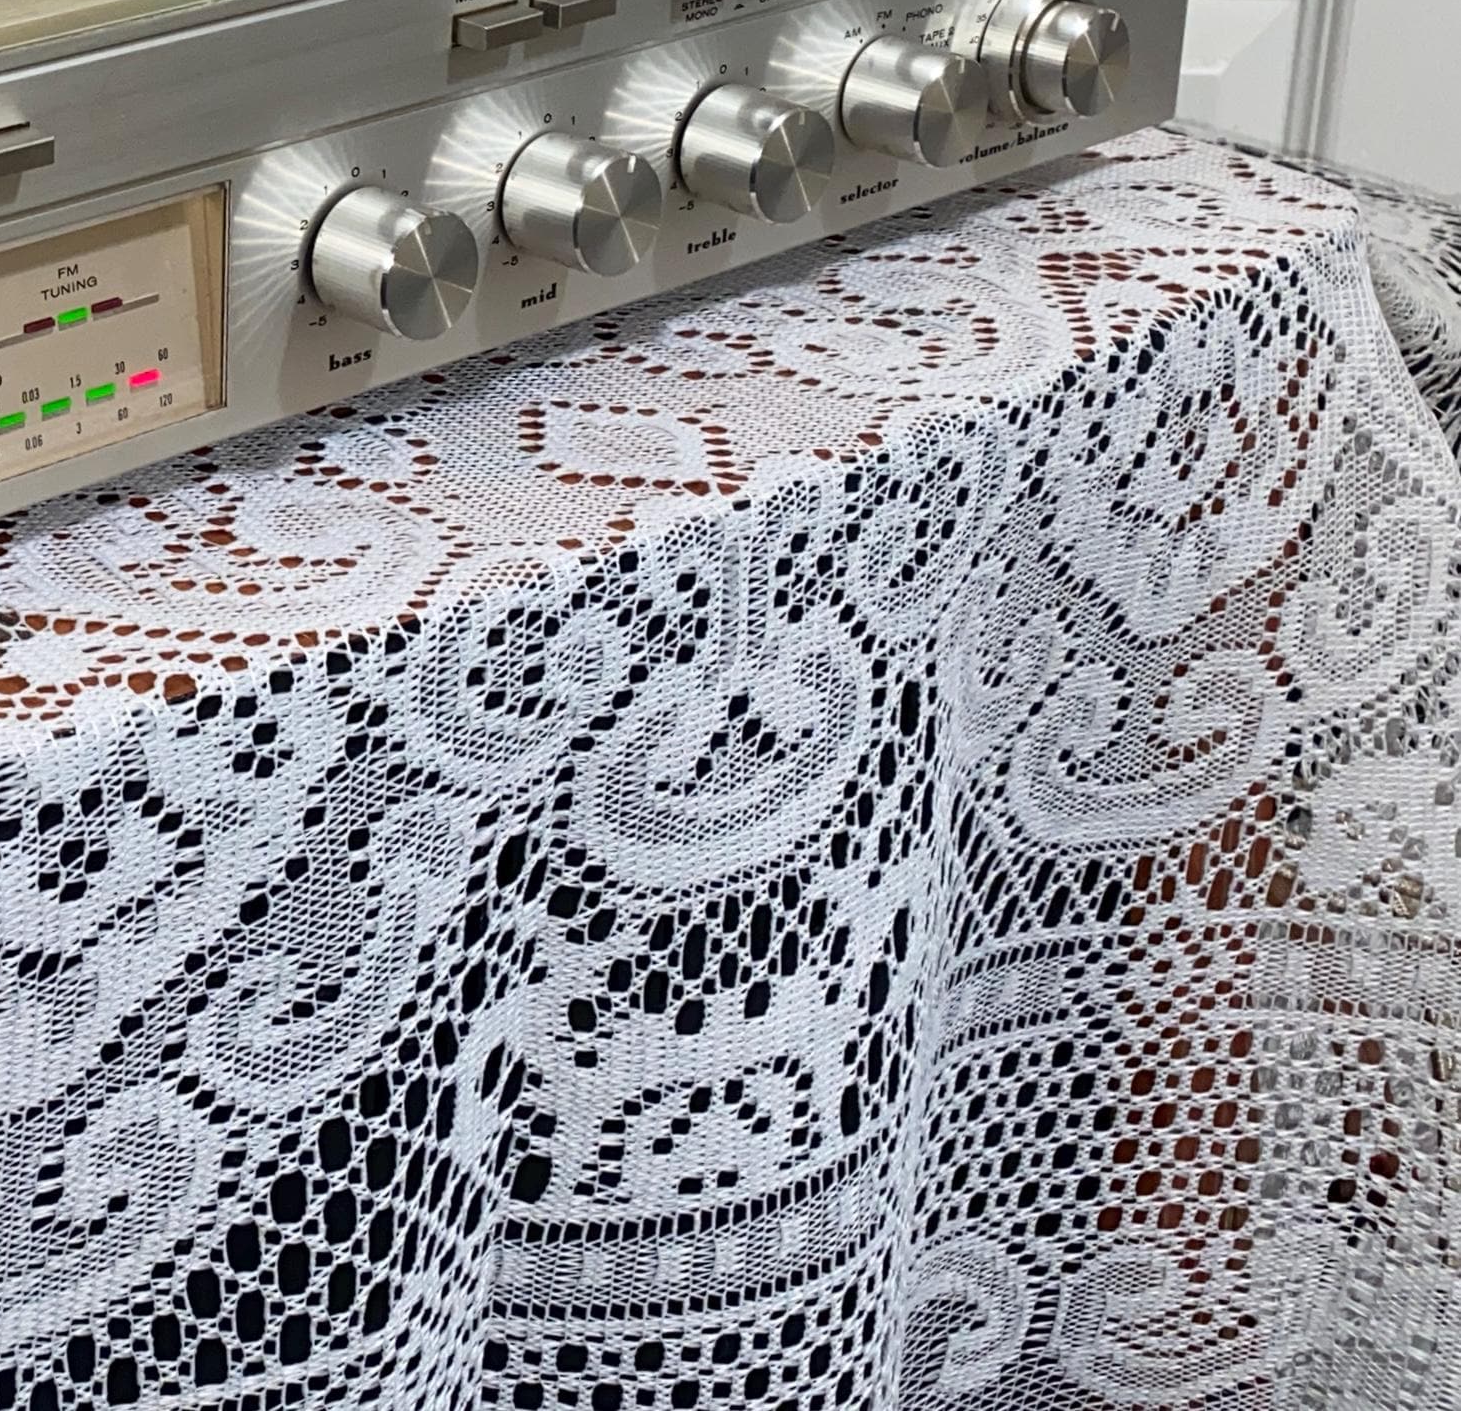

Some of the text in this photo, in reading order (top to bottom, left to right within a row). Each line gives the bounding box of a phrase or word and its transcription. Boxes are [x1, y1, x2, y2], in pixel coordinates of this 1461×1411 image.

[685, 7, 719, 23] MONO
[876, 9, 893, 21] FM
[905, 3, 944, 22] PHONO
[844, 26, 862, 39] AM
[920, 28, 946, 45] TAPE
[839, 178, 899, 205] selector
[687, 228, 737, 254] treble
[56, 263, 80, 280] FM
[40, 275, 99, 302] TUNING
[521, 283, 557, 309] mid
[329, 349, 373, 372] bass
[21, 387, 40, 405] 0.03
[114, 360, 126, 375] 30
[157, 347, 169, 362] 60
[24, 434, 43, 451] 0.06
[75, 421, 82, 435] 3
[158, 392, 173, 409] 120
